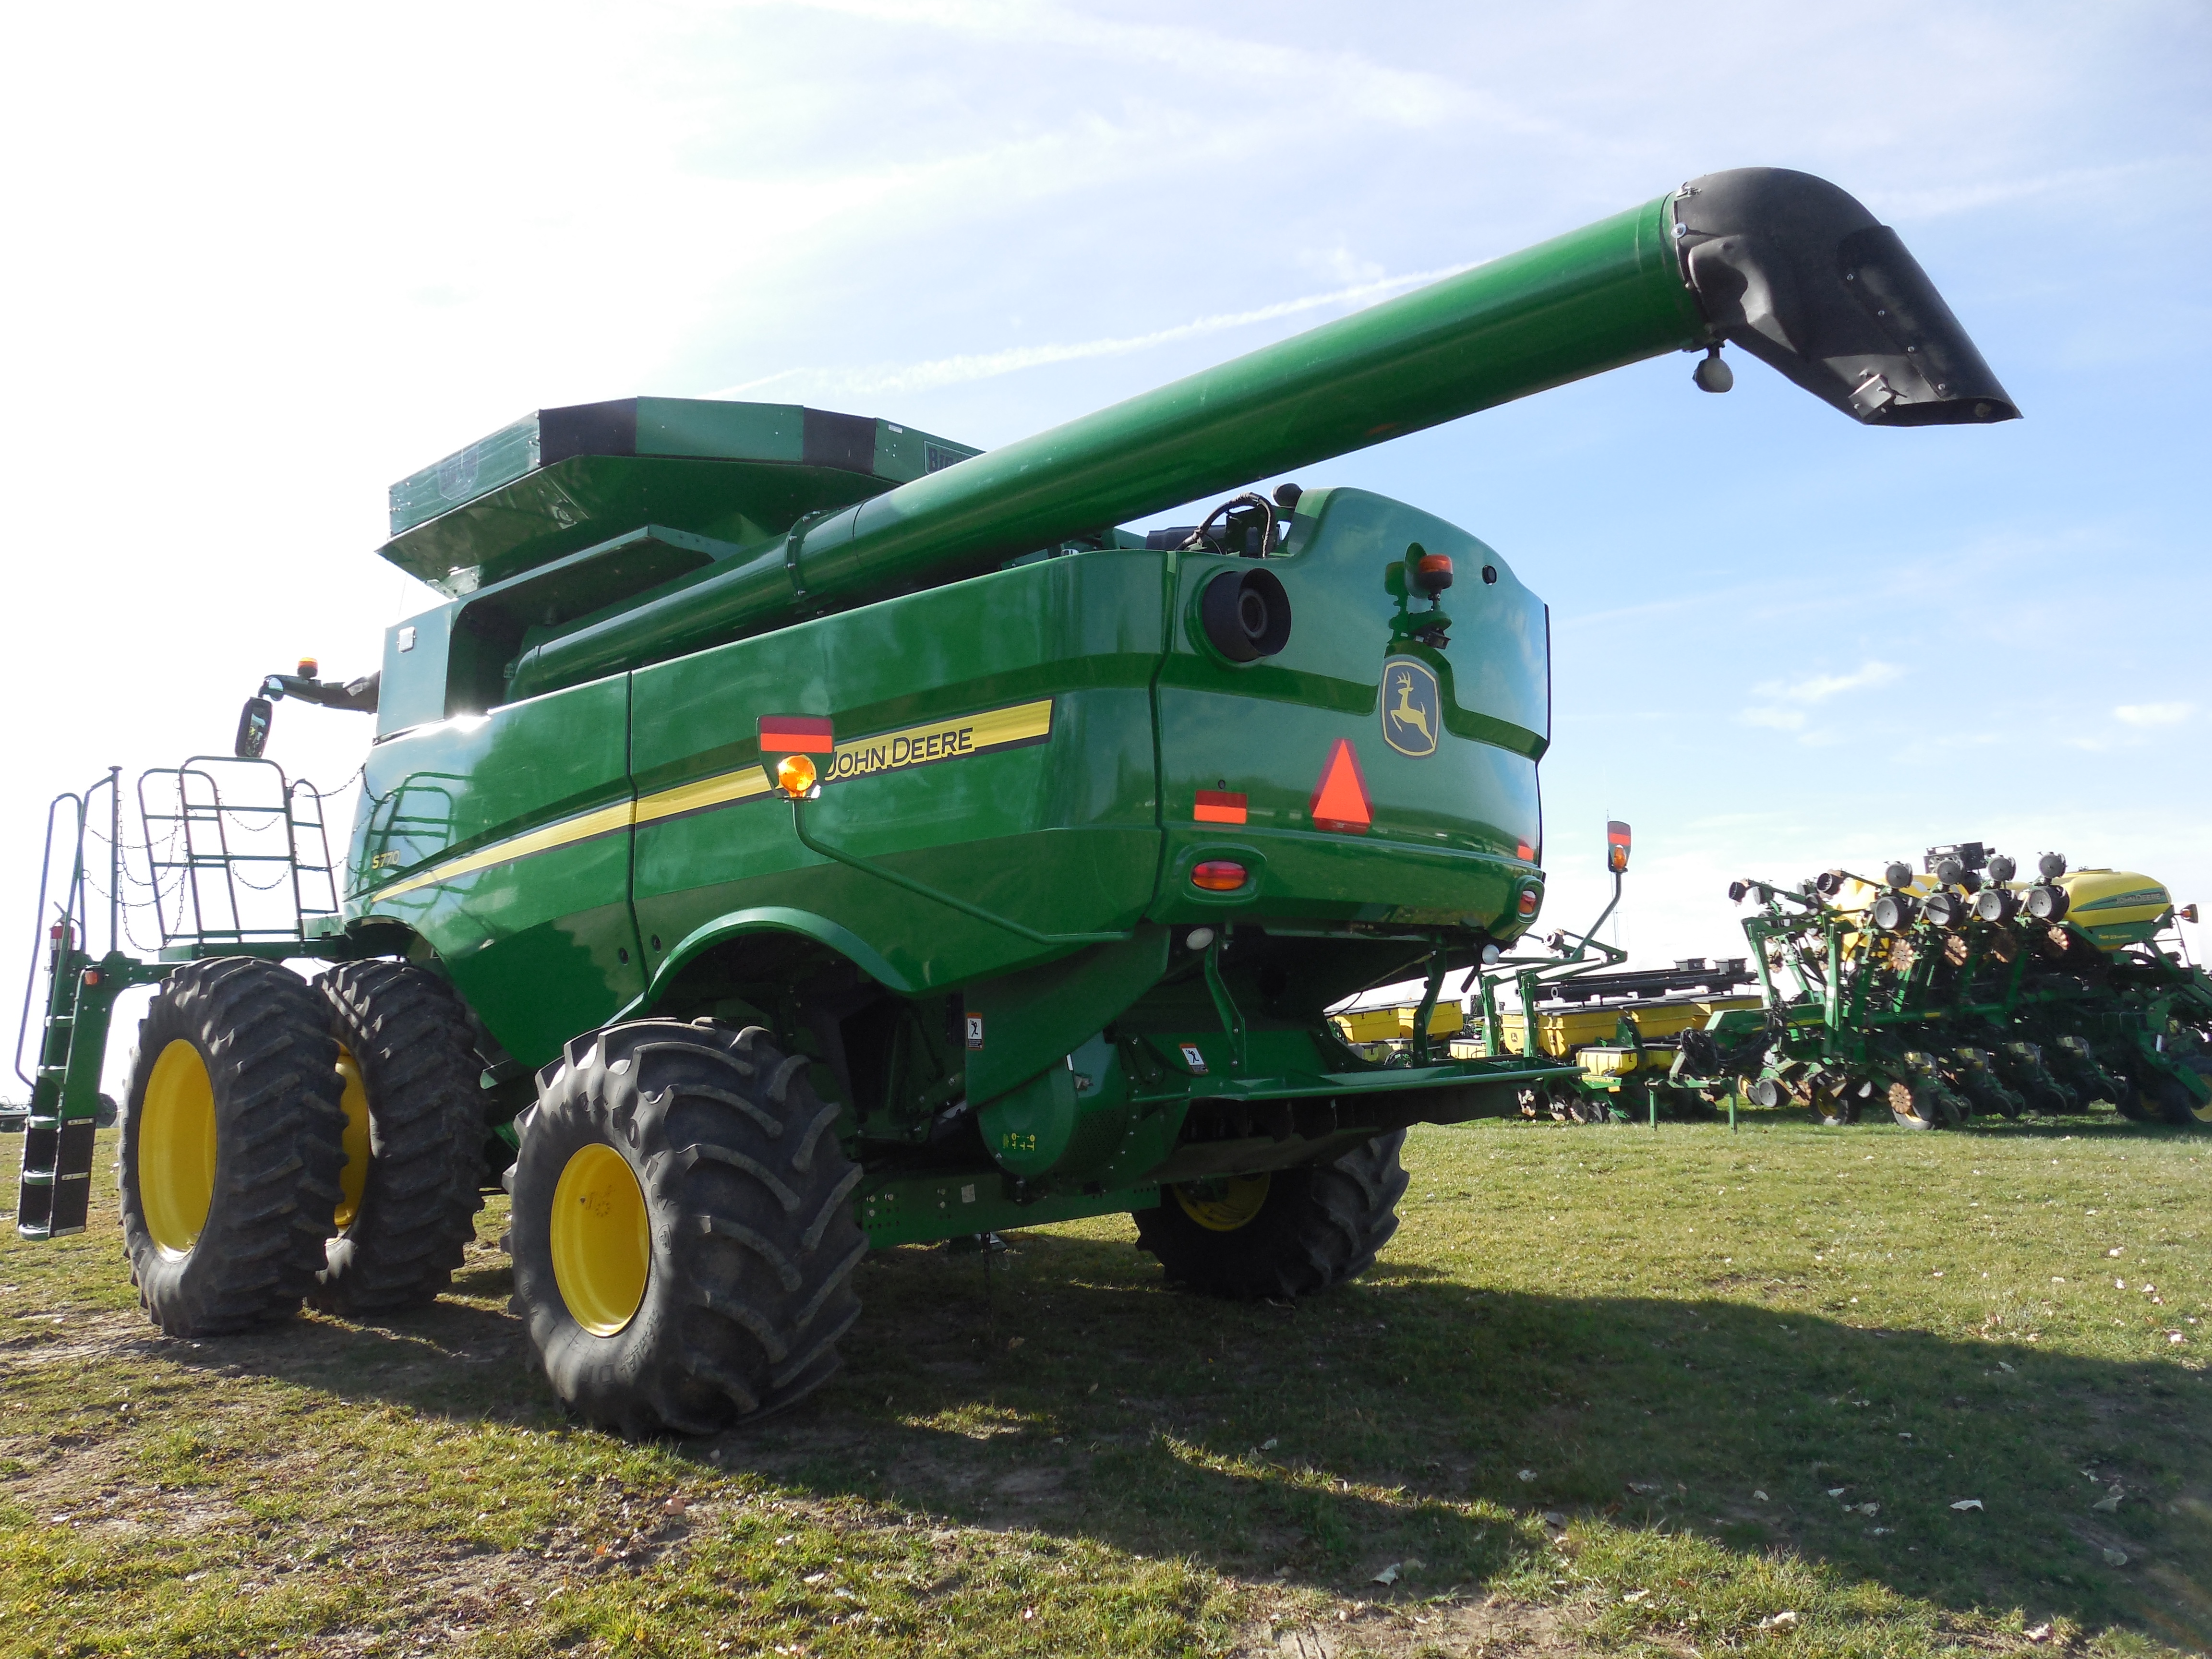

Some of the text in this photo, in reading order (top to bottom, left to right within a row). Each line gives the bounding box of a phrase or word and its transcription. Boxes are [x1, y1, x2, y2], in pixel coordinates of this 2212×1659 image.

[826, 727, 974, 775] JOHN DEERE
[372, 850, 400, 869] S770
